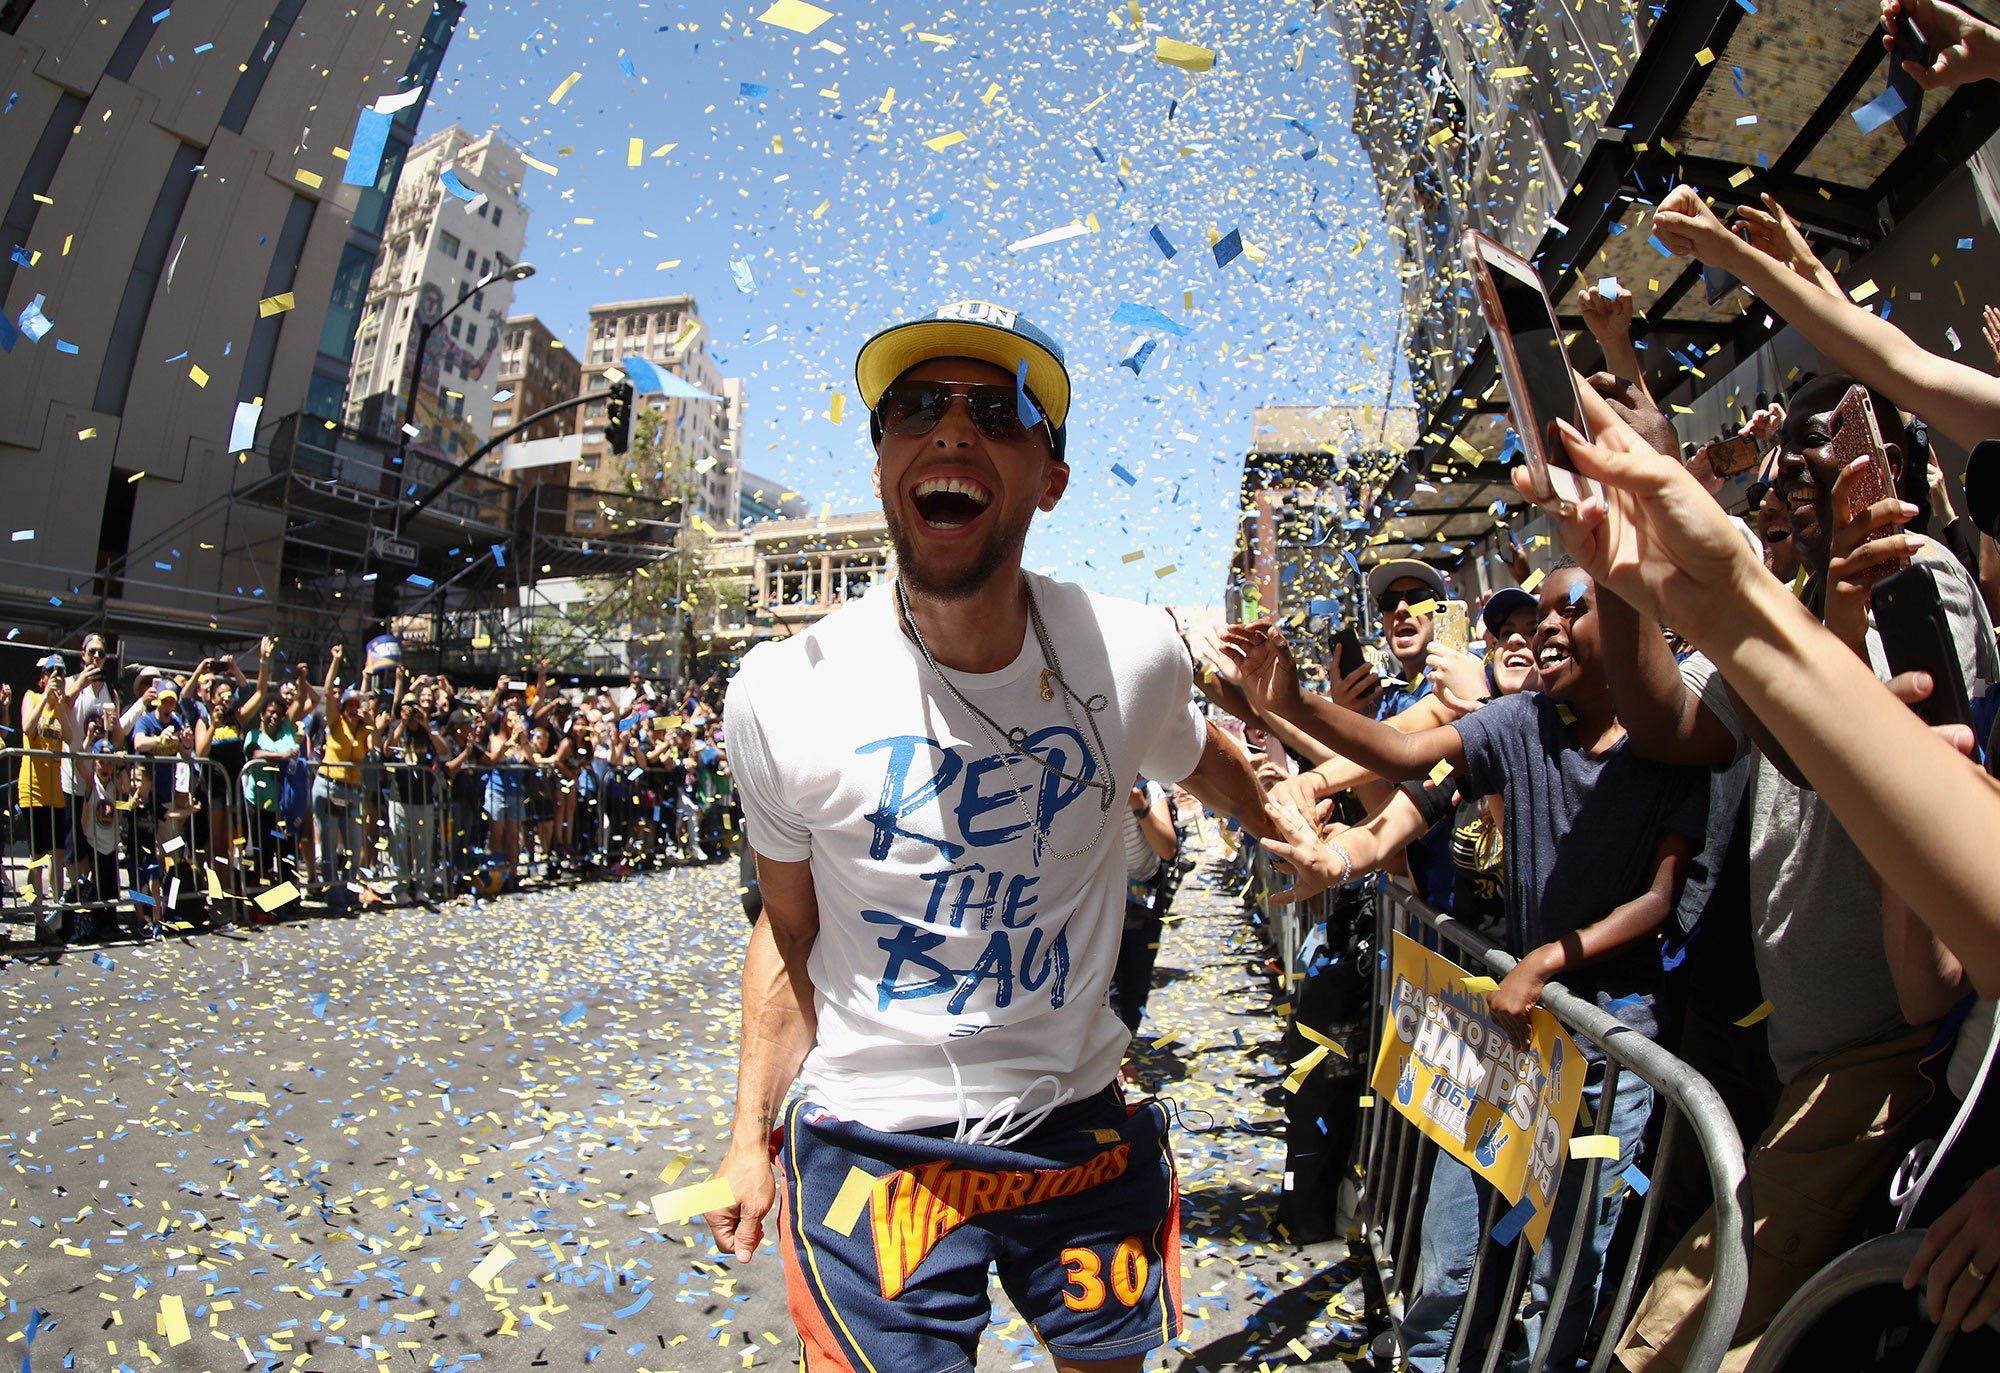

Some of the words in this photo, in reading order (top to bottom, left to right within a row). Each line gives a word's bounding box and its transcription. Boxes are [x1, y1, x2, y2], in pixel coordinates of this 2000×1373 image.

[936, 302, 1017, 330] RUN
[398, 547, 412, 556] WAY
[855, 726, 1096, 866] REP
[920, 863, 1040, 931] THE
[860, 908, 1077, 1015] BAY
[1396, 1004, 1535, 1131] CHAMPS
[1399, 978, 1451, 1029] BACK
[1454, 1013, 1484, 1046] TO
[1484, 1028, 1542, 1094] BACK
[1421, 1089, 1468, 1137] KMEL
[1430, 1074, 1478, 1117] 106.1
[869, 1141, 1132, 1300] WARRIORS
[1061, 1236, 1149, 1313] 30
